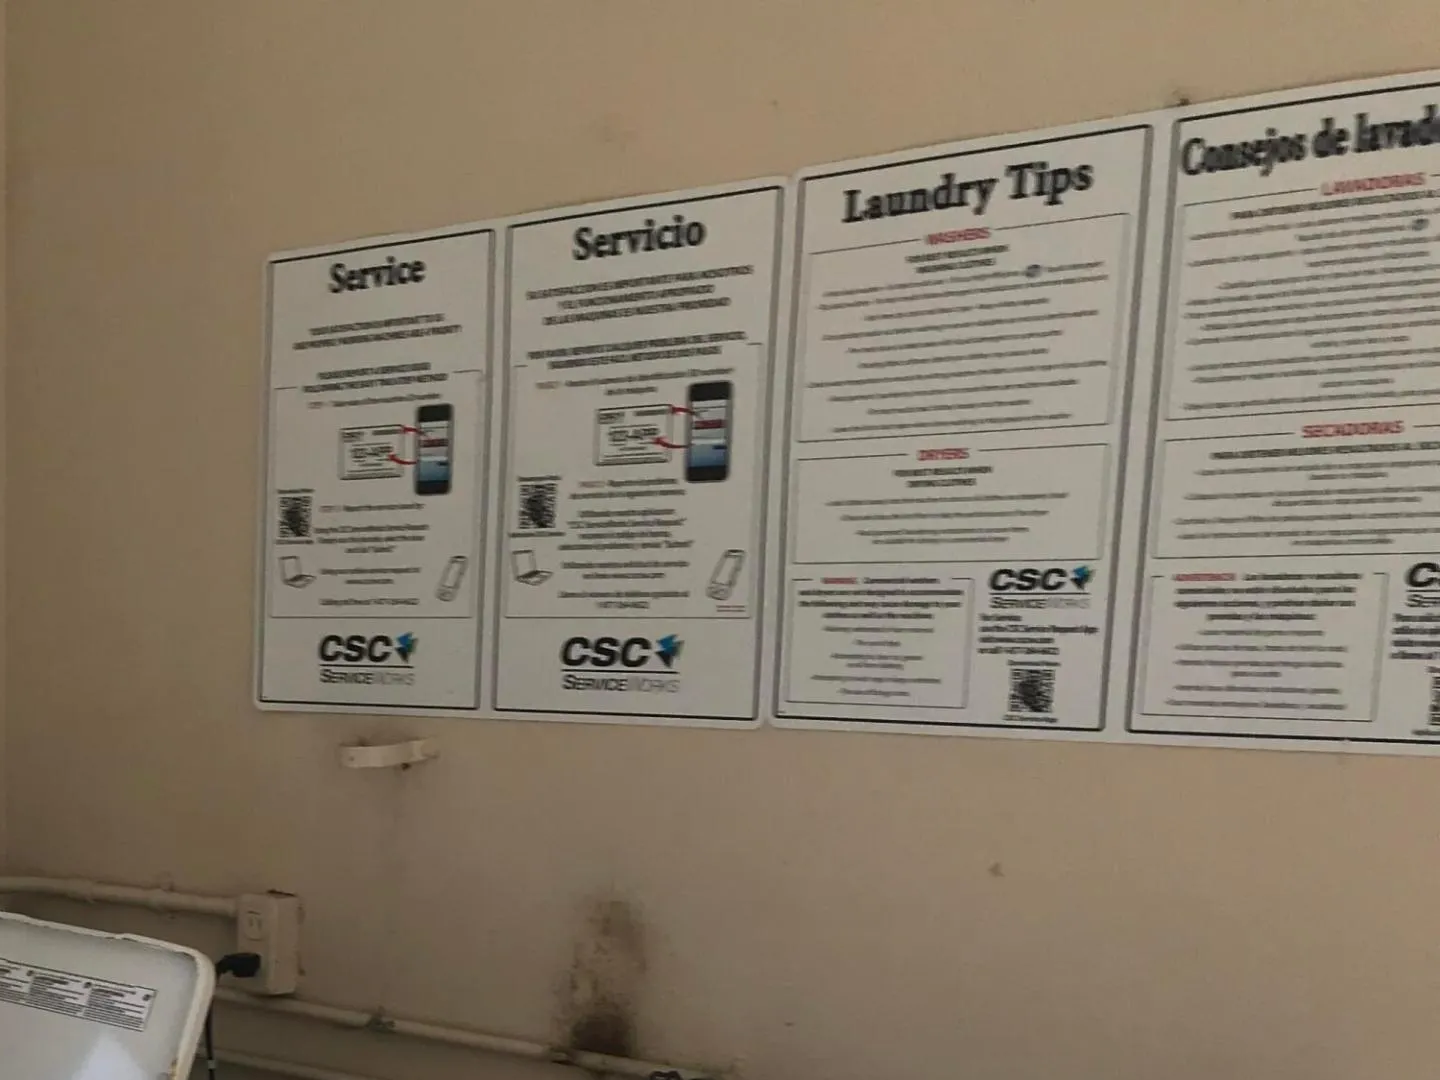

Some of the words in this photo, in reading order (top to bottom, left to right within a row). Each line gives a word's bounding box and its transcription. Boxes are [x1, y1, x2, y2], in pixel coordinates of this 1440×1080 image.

[1181, 127, 1308, 177] Consejos
[1312, 117, 1349, 159] de
[1352, 104, 1440, 153] lavad
[841, 172, 1000, 224] Laundry
[1005, 160, 1094, 206] Tips
[572, 214, 708, 261] Servicio
[328, 255, 428, 294] Service
[989, 568, 1068, 591] CSC
[319, 634, 394, 662] CSC
[561, 636, 653, 668] CSC
